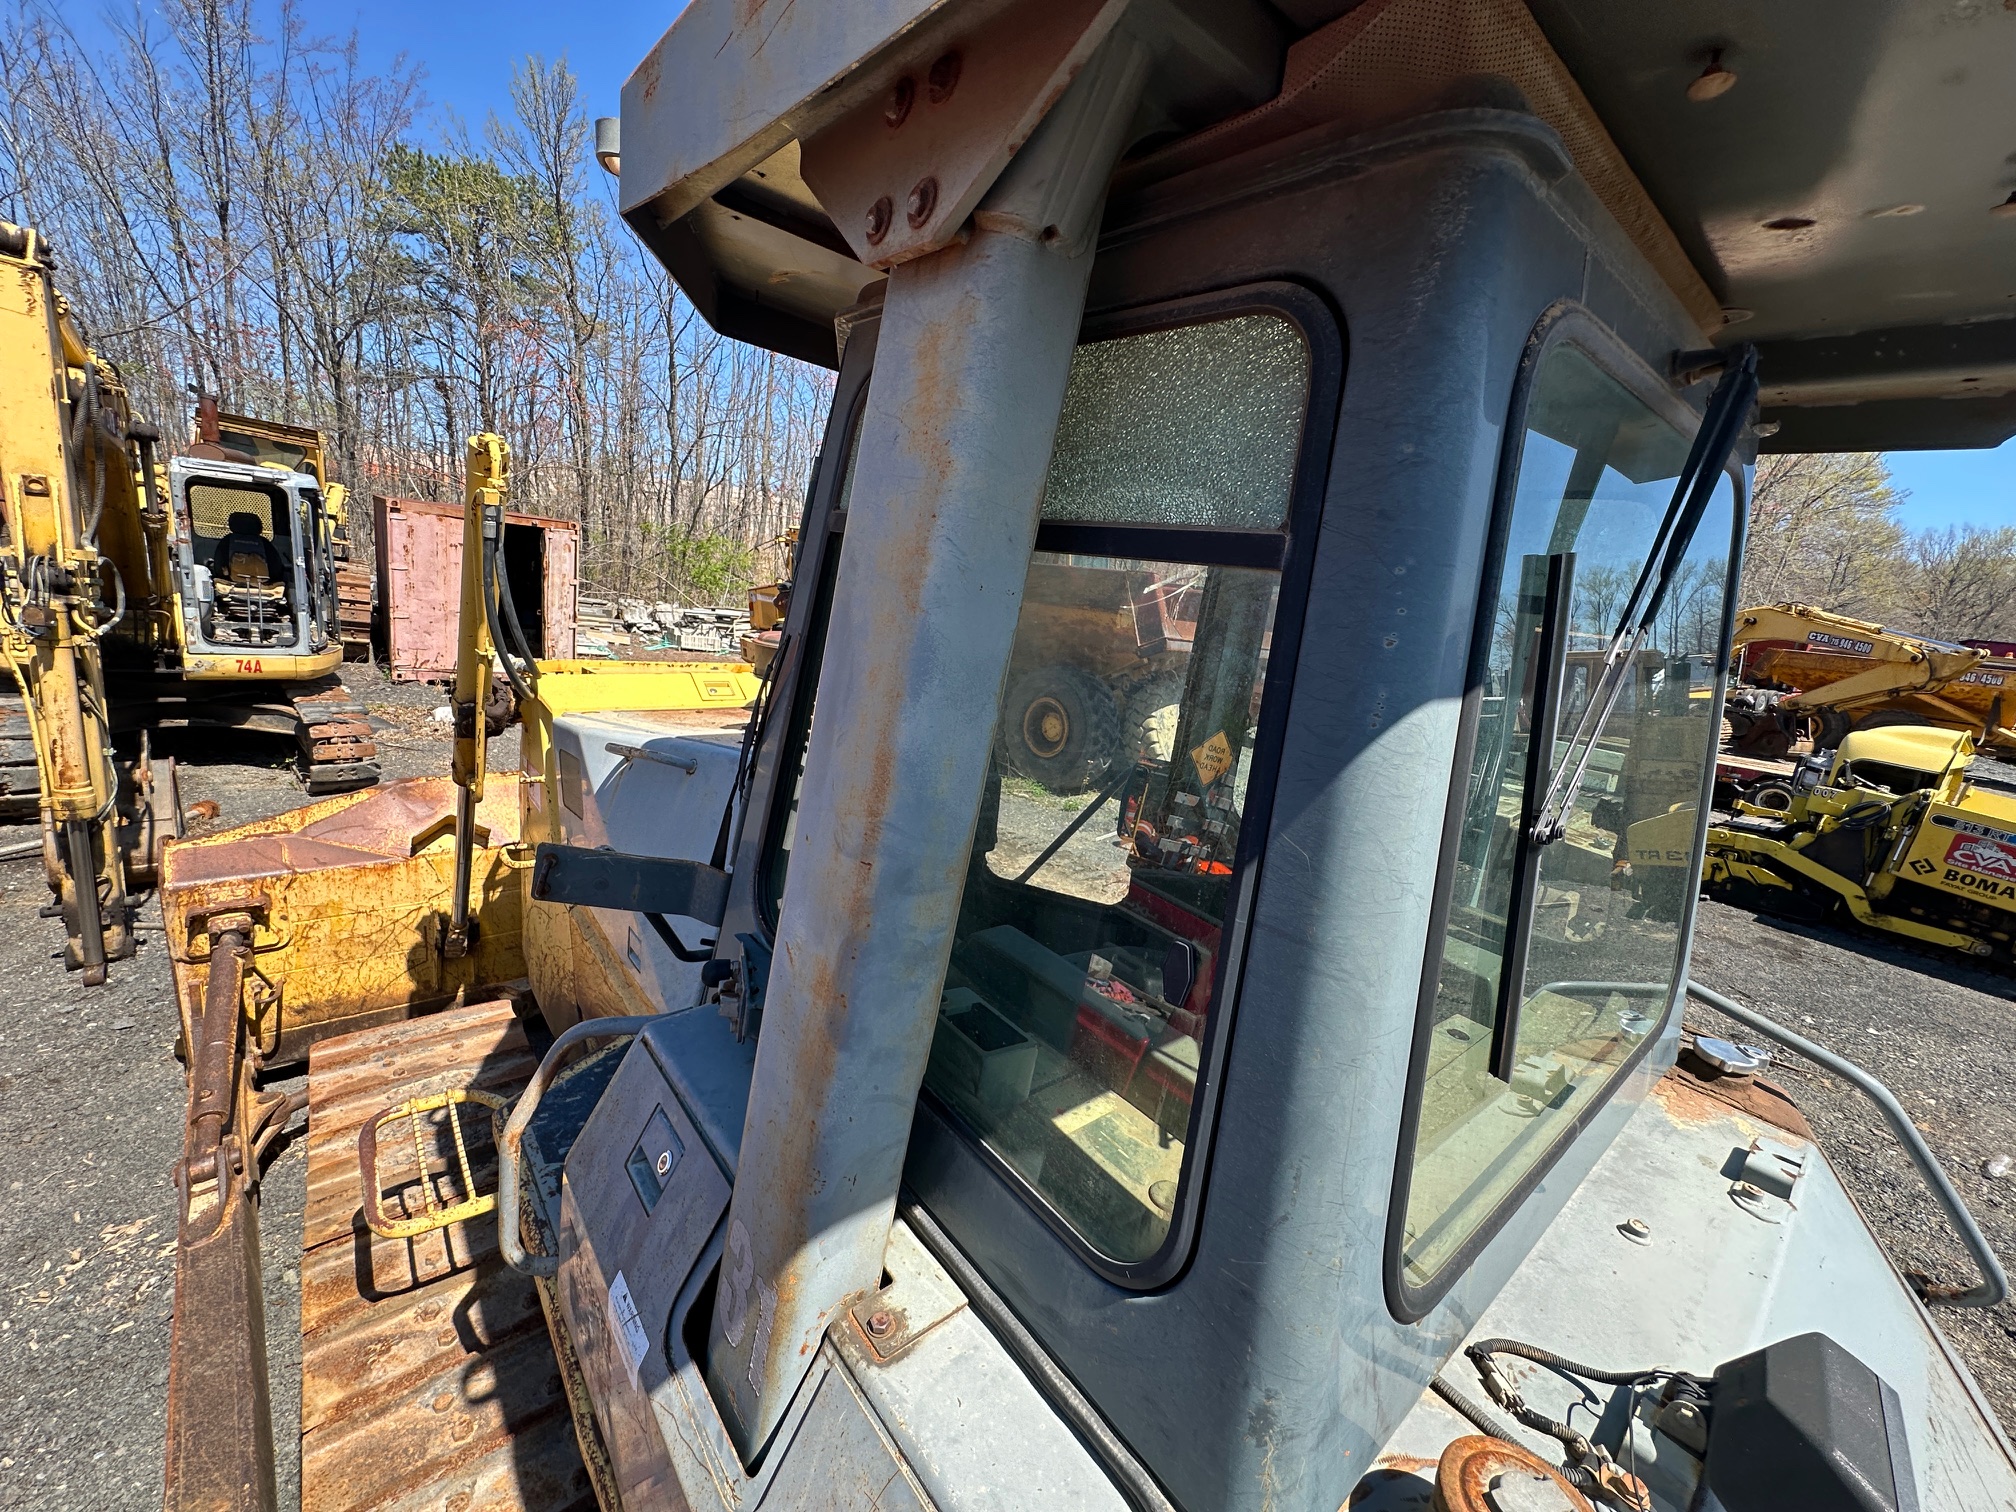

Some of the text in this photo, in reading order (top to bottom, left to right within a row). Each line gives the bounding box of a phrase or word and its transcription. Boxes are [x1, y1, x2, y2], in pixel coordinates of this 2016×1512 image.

[1809, 632, 1830, 643] CVA
[1840, 639, 1853, 650] 946
[1854, 642, 1873, 654] 4500
[235, 659, 263, 673] 74A
[1813, 788, 1838, 799] 007
[1947, 858, 1968, 869] Site
[1953, 850, 2011, 874] CVA
[1940, 880, 1998, 900] FAYAT GROUP
